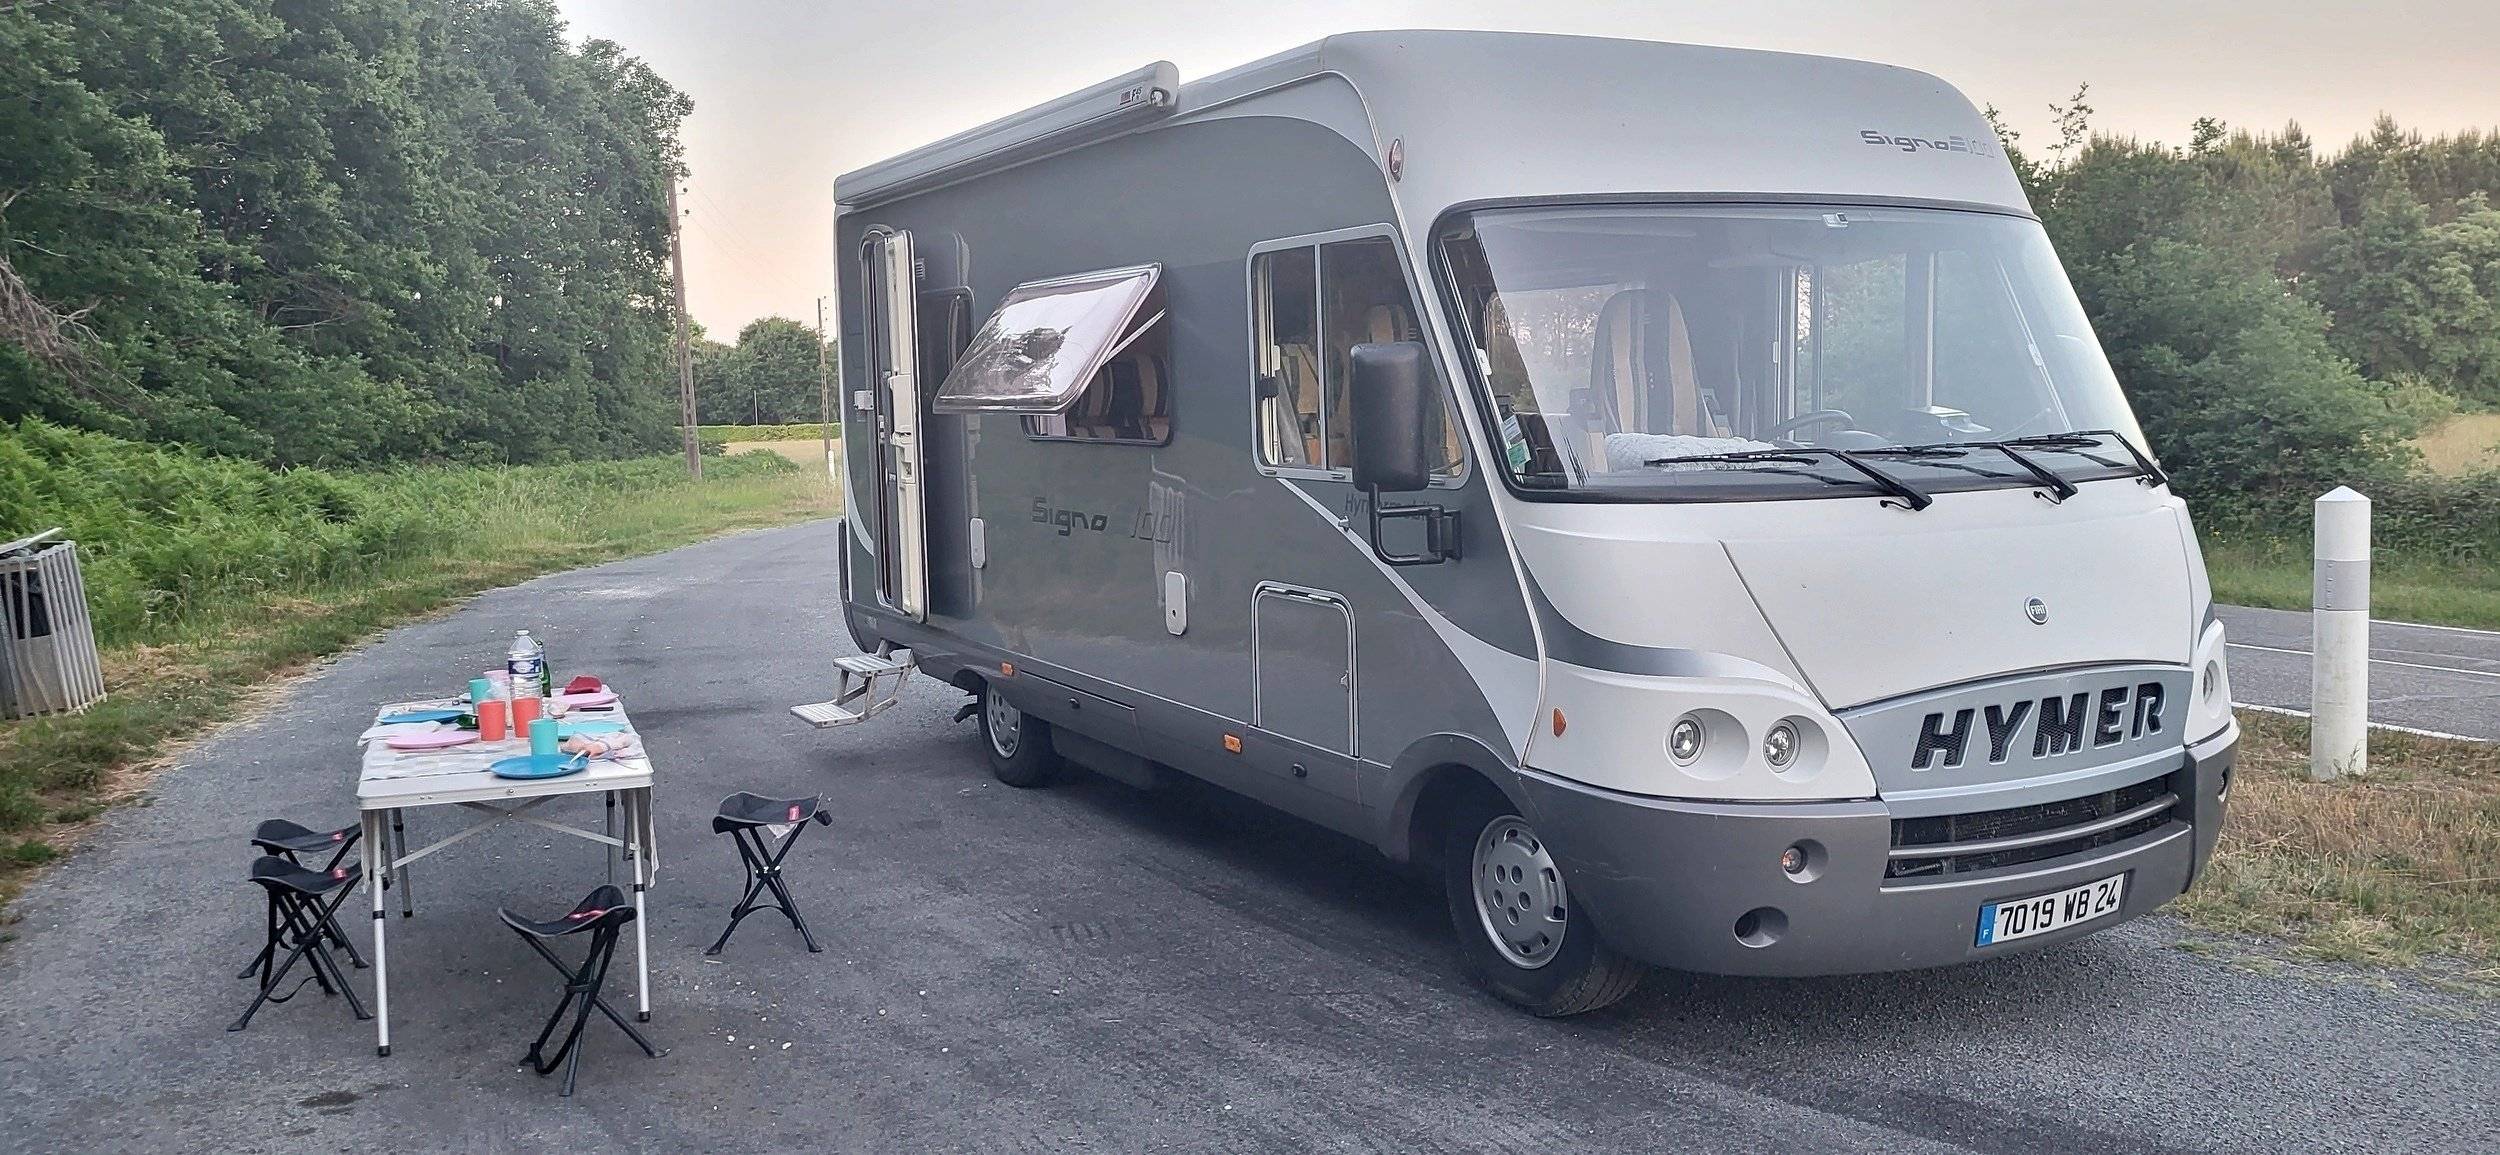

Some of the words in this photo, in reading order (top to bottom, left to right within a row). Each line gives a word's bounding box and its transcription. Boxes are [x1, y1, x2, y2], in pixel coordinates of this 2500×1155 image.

[1860, 130, 1950, 152] Signo
[1031, 495, 1109, 537] Signo
[1910, 681, 2168, 772] HYMER
[1982, 928, 1990, 940] F
[2000, 898, 2056, 937] 7019
[2063, 888, 2091, 923] WB
[2094, 879, 2118, 914] 24
